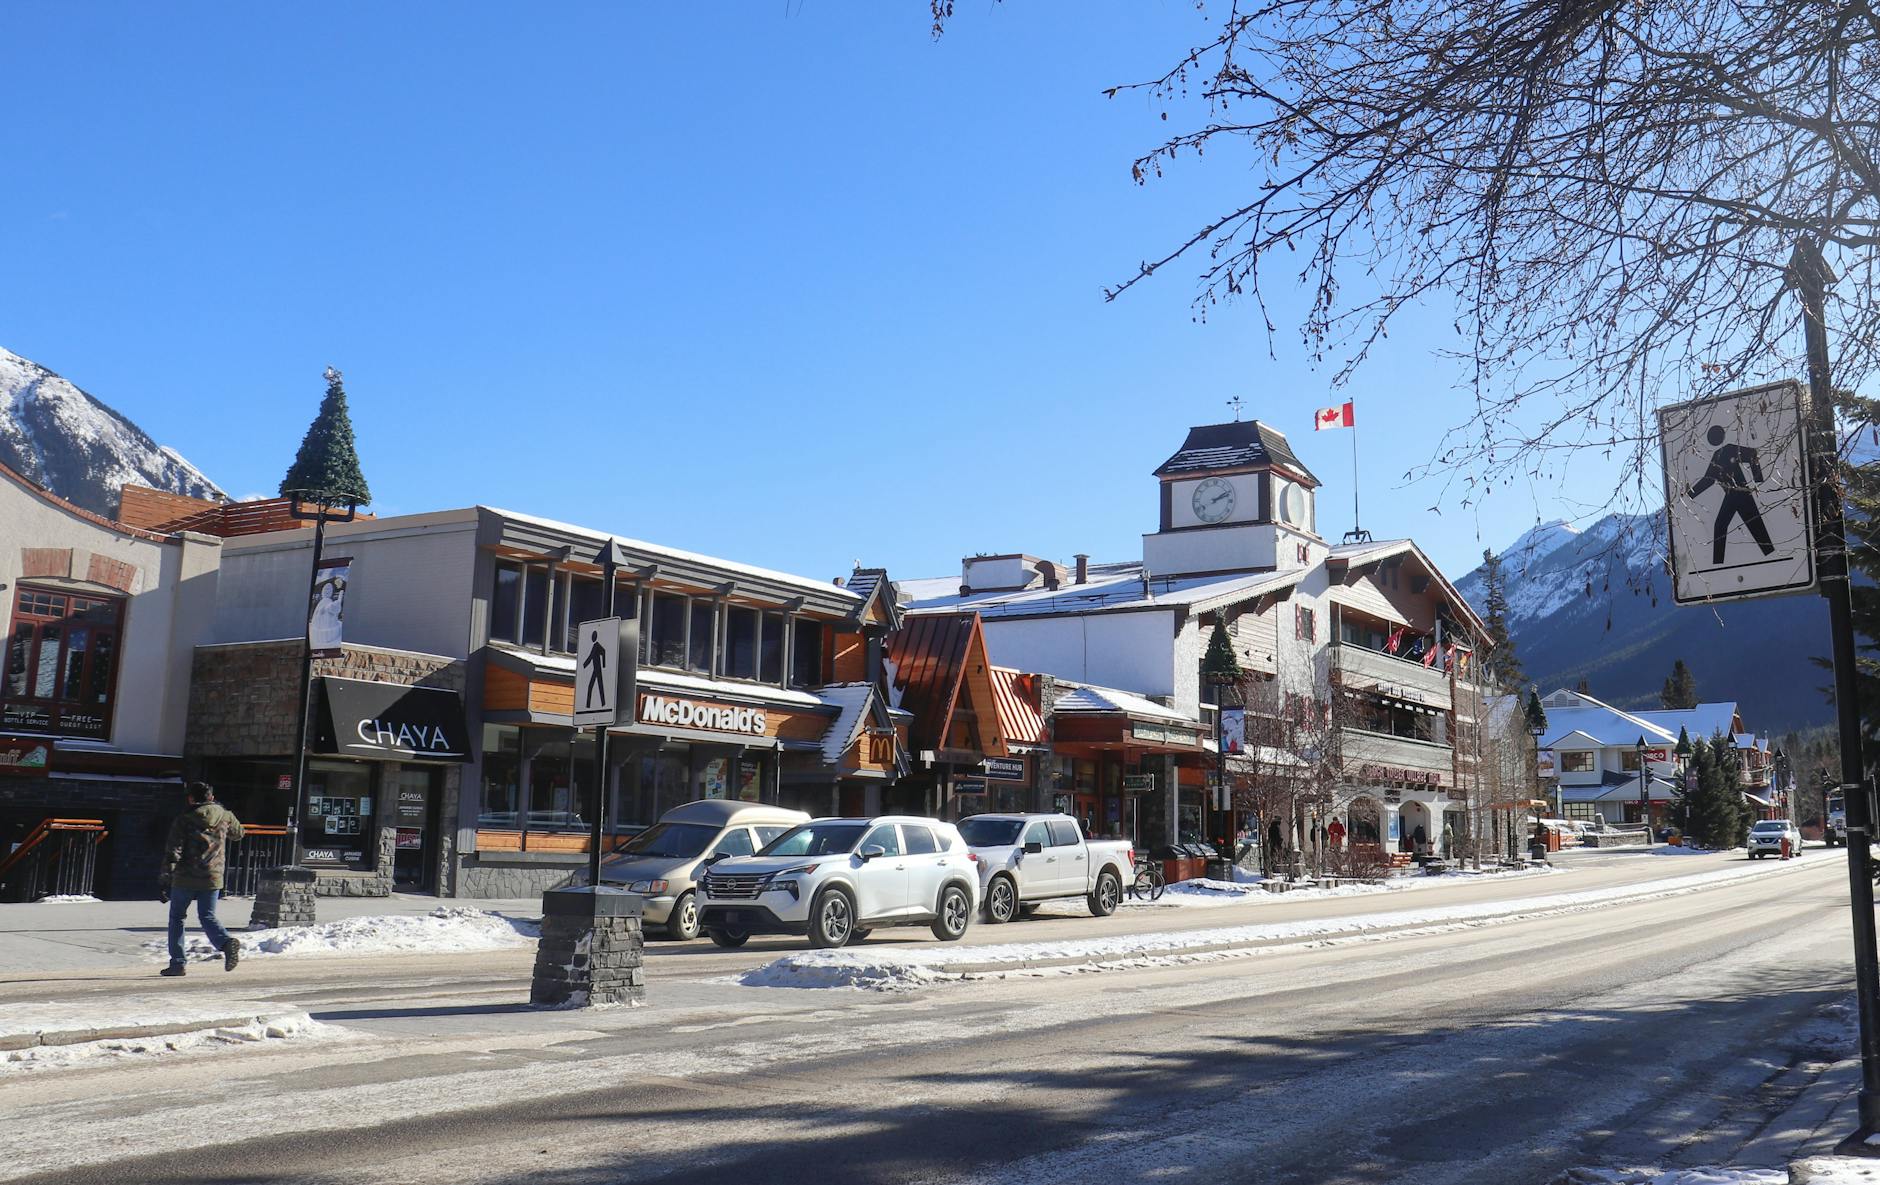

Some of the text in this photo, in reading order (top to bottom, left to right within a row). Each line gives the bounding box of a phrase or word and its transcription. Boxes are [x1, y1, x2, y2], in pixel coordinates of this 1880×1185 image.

[642, 695, 766, 733] McDonald's
[26, 718, 49, 726] SERVICE
[71, 714, 92, 723] FREE
[357, 719, 450, 749] CHAYA
[1012, 764, 1022, 772] HUB
[308, 850, 334, 858] CHAYA
